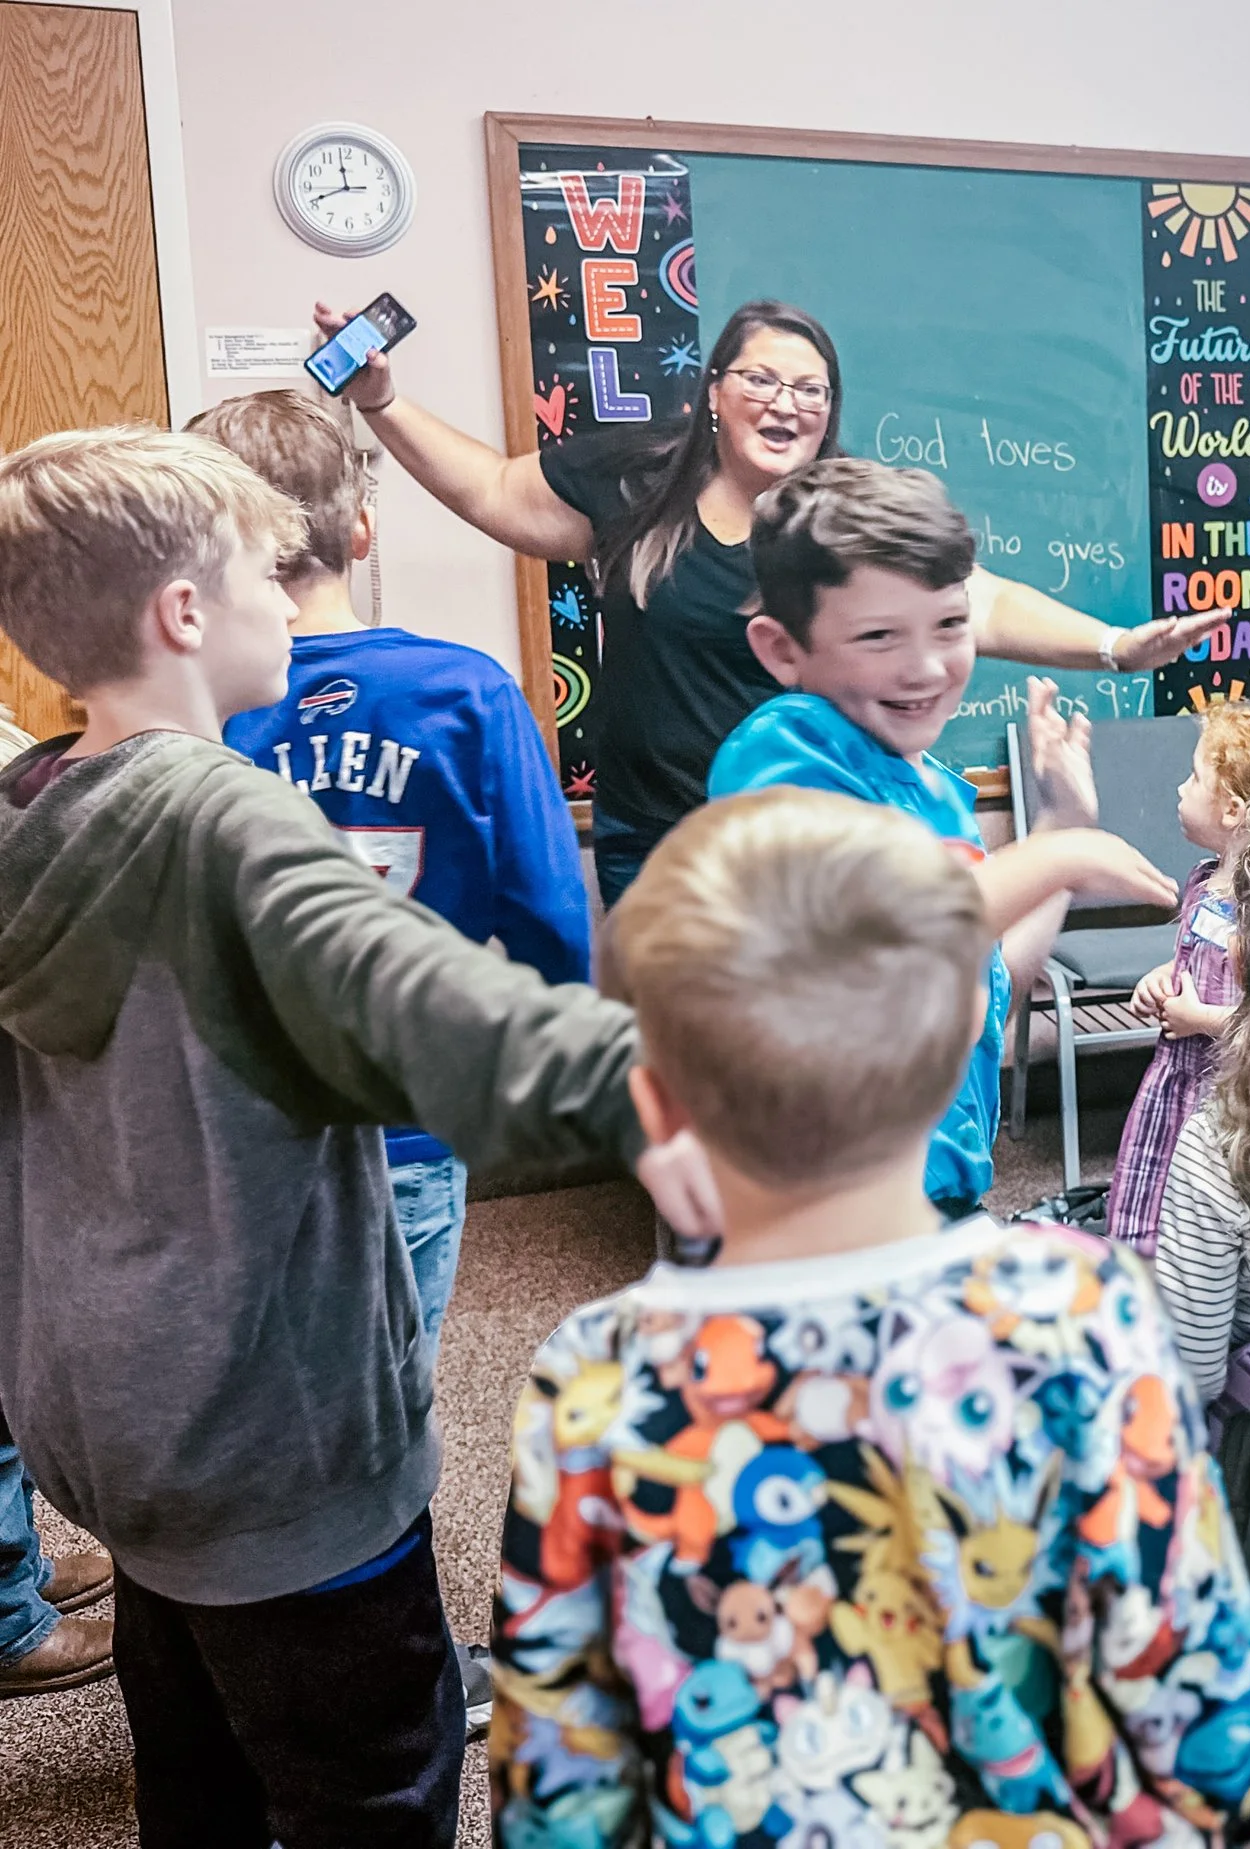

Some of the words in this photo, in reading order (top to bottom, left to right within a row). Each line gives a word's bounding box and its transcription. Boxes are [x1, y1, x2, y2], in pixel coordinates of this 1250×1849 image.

[321, 151, 333, 165] 11
[363, 153, 368, 166] 1
[308, 164, 322, 177] 10
[375, 167, 385, 180] 2
[303, 180, 312, 193] 9
[382, 184, 391, 197] 3
[376, 201, 384, 214] 4
[326, 212, 335, 225] 7
[344, 217, 354, 230] 6
[364, 213, 373, 226] 5
[1192, 279, 1226, 313] THE
[1180, 372, 1203, 404] OF
[1210, 373, 1244, 404] THE
[876, 412, 948, 469] God
[980, 417, 1077, 472] loves
[1206, 475, 1229, 496] is
[1161, 522, 1195, 559] IN
[968, 513, 1022, 555] ho
[1047, 531, 1125, 593] gives
[949, 683, 1089, 720] orinthns
[1096, 677, 1150, 720] 9:7
[273, 730, 421, 804] LLEN
